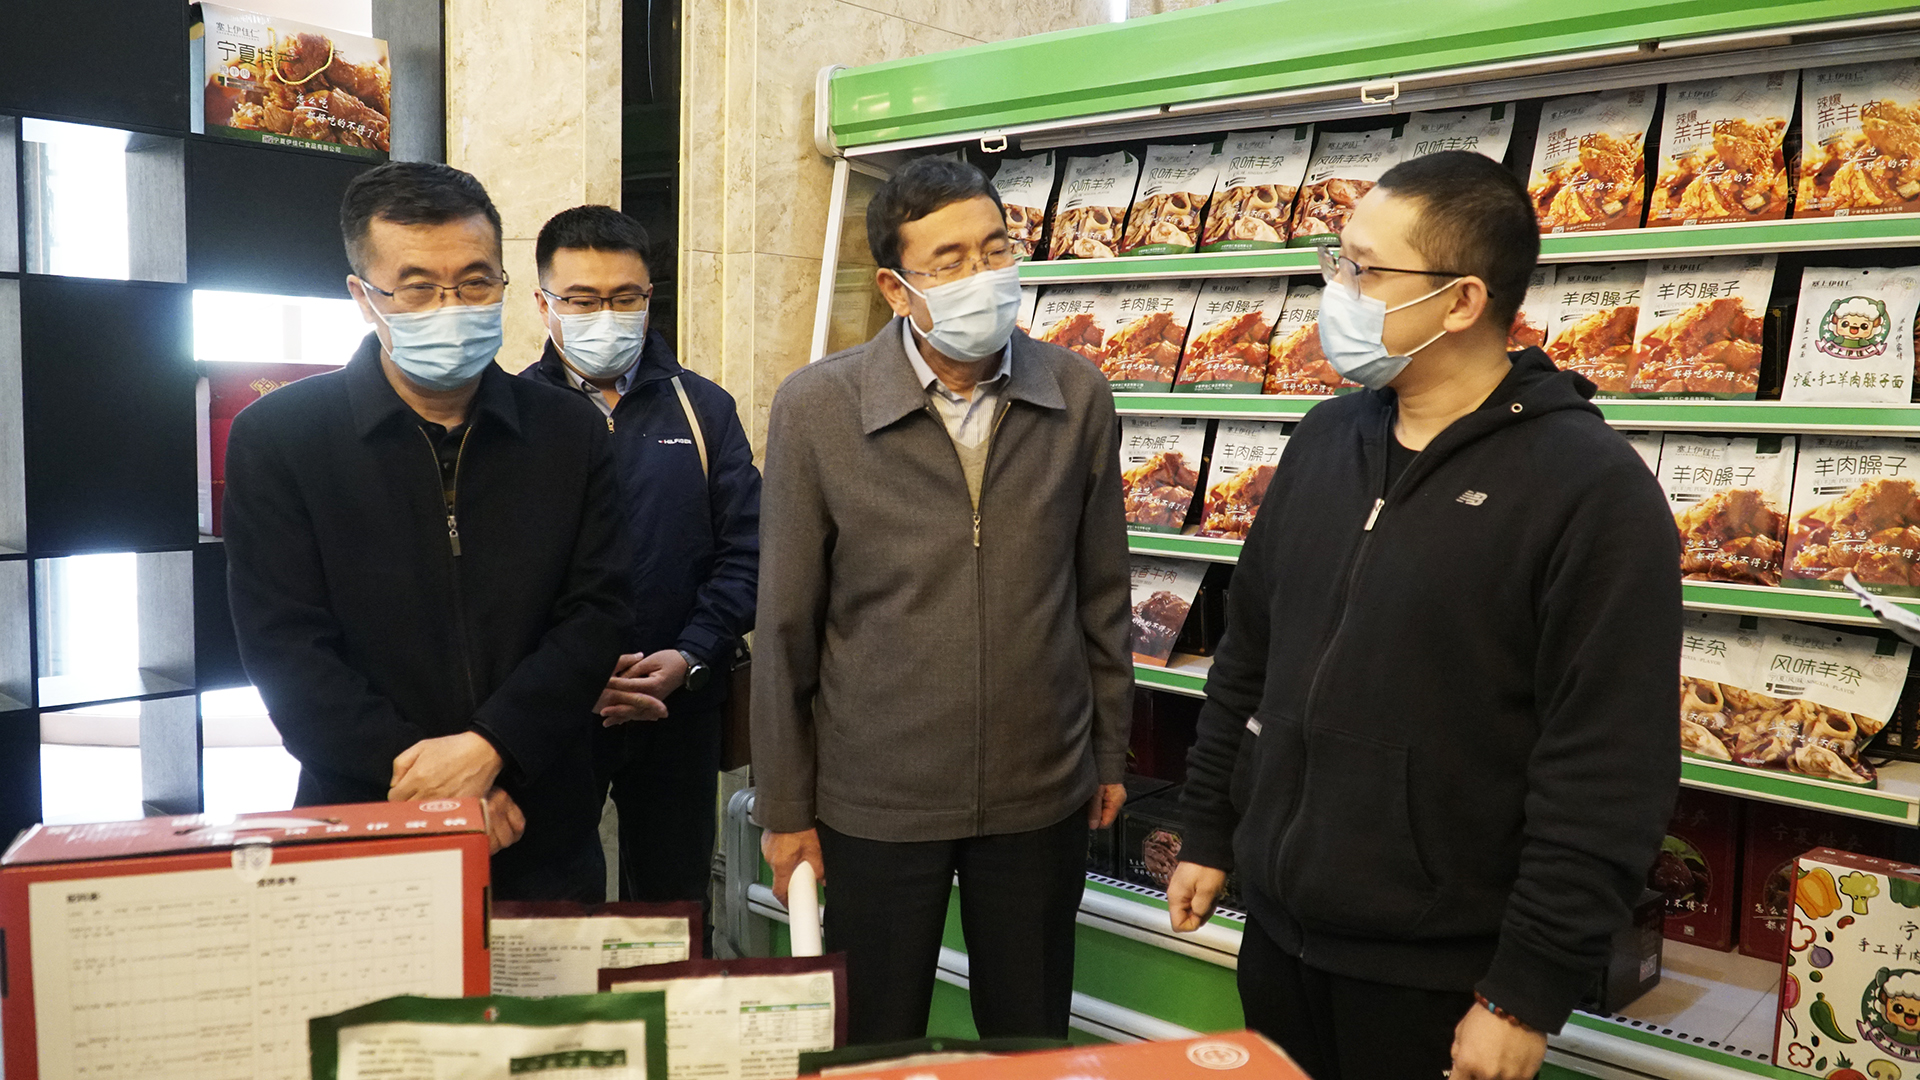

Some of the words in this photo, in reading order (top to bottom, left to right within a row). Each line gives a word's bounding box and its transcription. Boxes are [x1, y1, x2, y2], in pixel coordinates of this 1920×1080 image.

[216, 22, 260, 39] 塞上伊佳仁
[217, 40, 299, 69] 宁夏特产
[1817, 93, 1841, 109] 辣爆
[1676, 110, 1697, 125] 辣爆
[1817, 100, 1882, 130] 羔羊肉
[1673, 118, 1733, 144] 羔羊肉
[1545, 133, 1597, 160] 羔羊肉
[1228, 155, 1285, 171] 风味羊杂
[1148, 167, 1200, 183] 风味羊杂
[1068, 177, 1116, 193] 风味羊杂
[1561, 290, 1641, 306] 羊肉臊子
[1657, 280, 1740, 300] 羊肉臊子
[1045, 300, 1095, 314] 羊肉臊子
[1119, 297, 1174, 312] 羊肉臊子
[1206, 299, 1265, 314] 羊肉臊子
[1129, 435, 1180, 450] 羊肉臊子
[1222, 443, 1278, 462] 羊肉臊子
[1815, 455, 1907, 477] 羊肉臊子
[1672, 465, 1755, 486] 羊肉臊子
[1770, 654, 1863, 687] 风味羊杂
